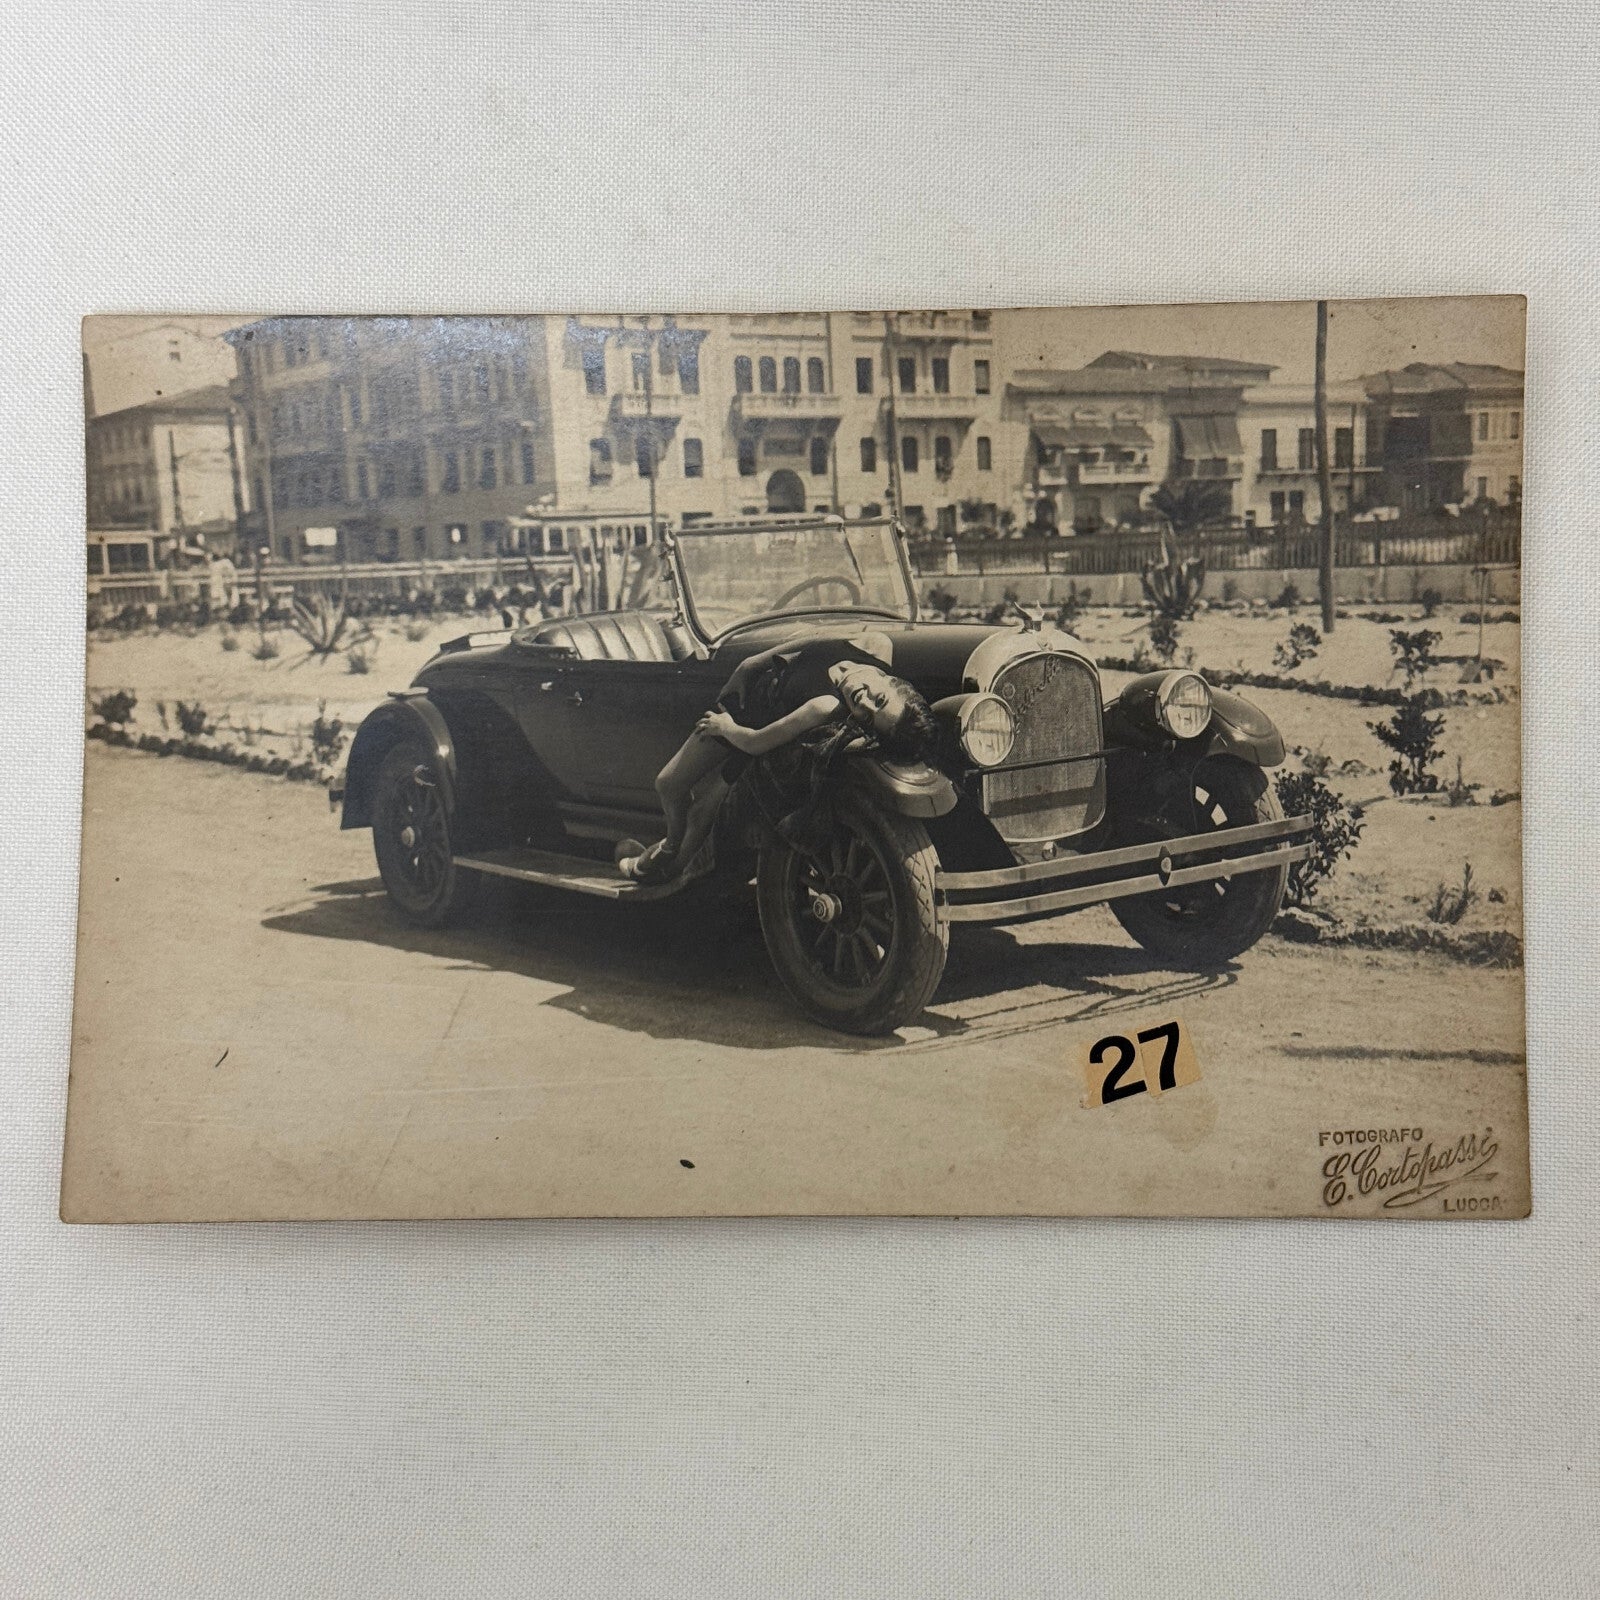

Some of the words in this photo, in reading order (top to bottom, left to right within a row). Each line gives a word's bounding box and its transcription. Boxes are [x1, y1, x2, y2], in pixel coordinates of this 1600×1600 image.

[1090, 1021, 1179, 1104] 27
[1319, 1127, 1423, 1147] FOTOGRAFO
[1351, 1127, 1498, 1197] Cortopassi
[1443, 1196, 1503, 1213] LUCCA
